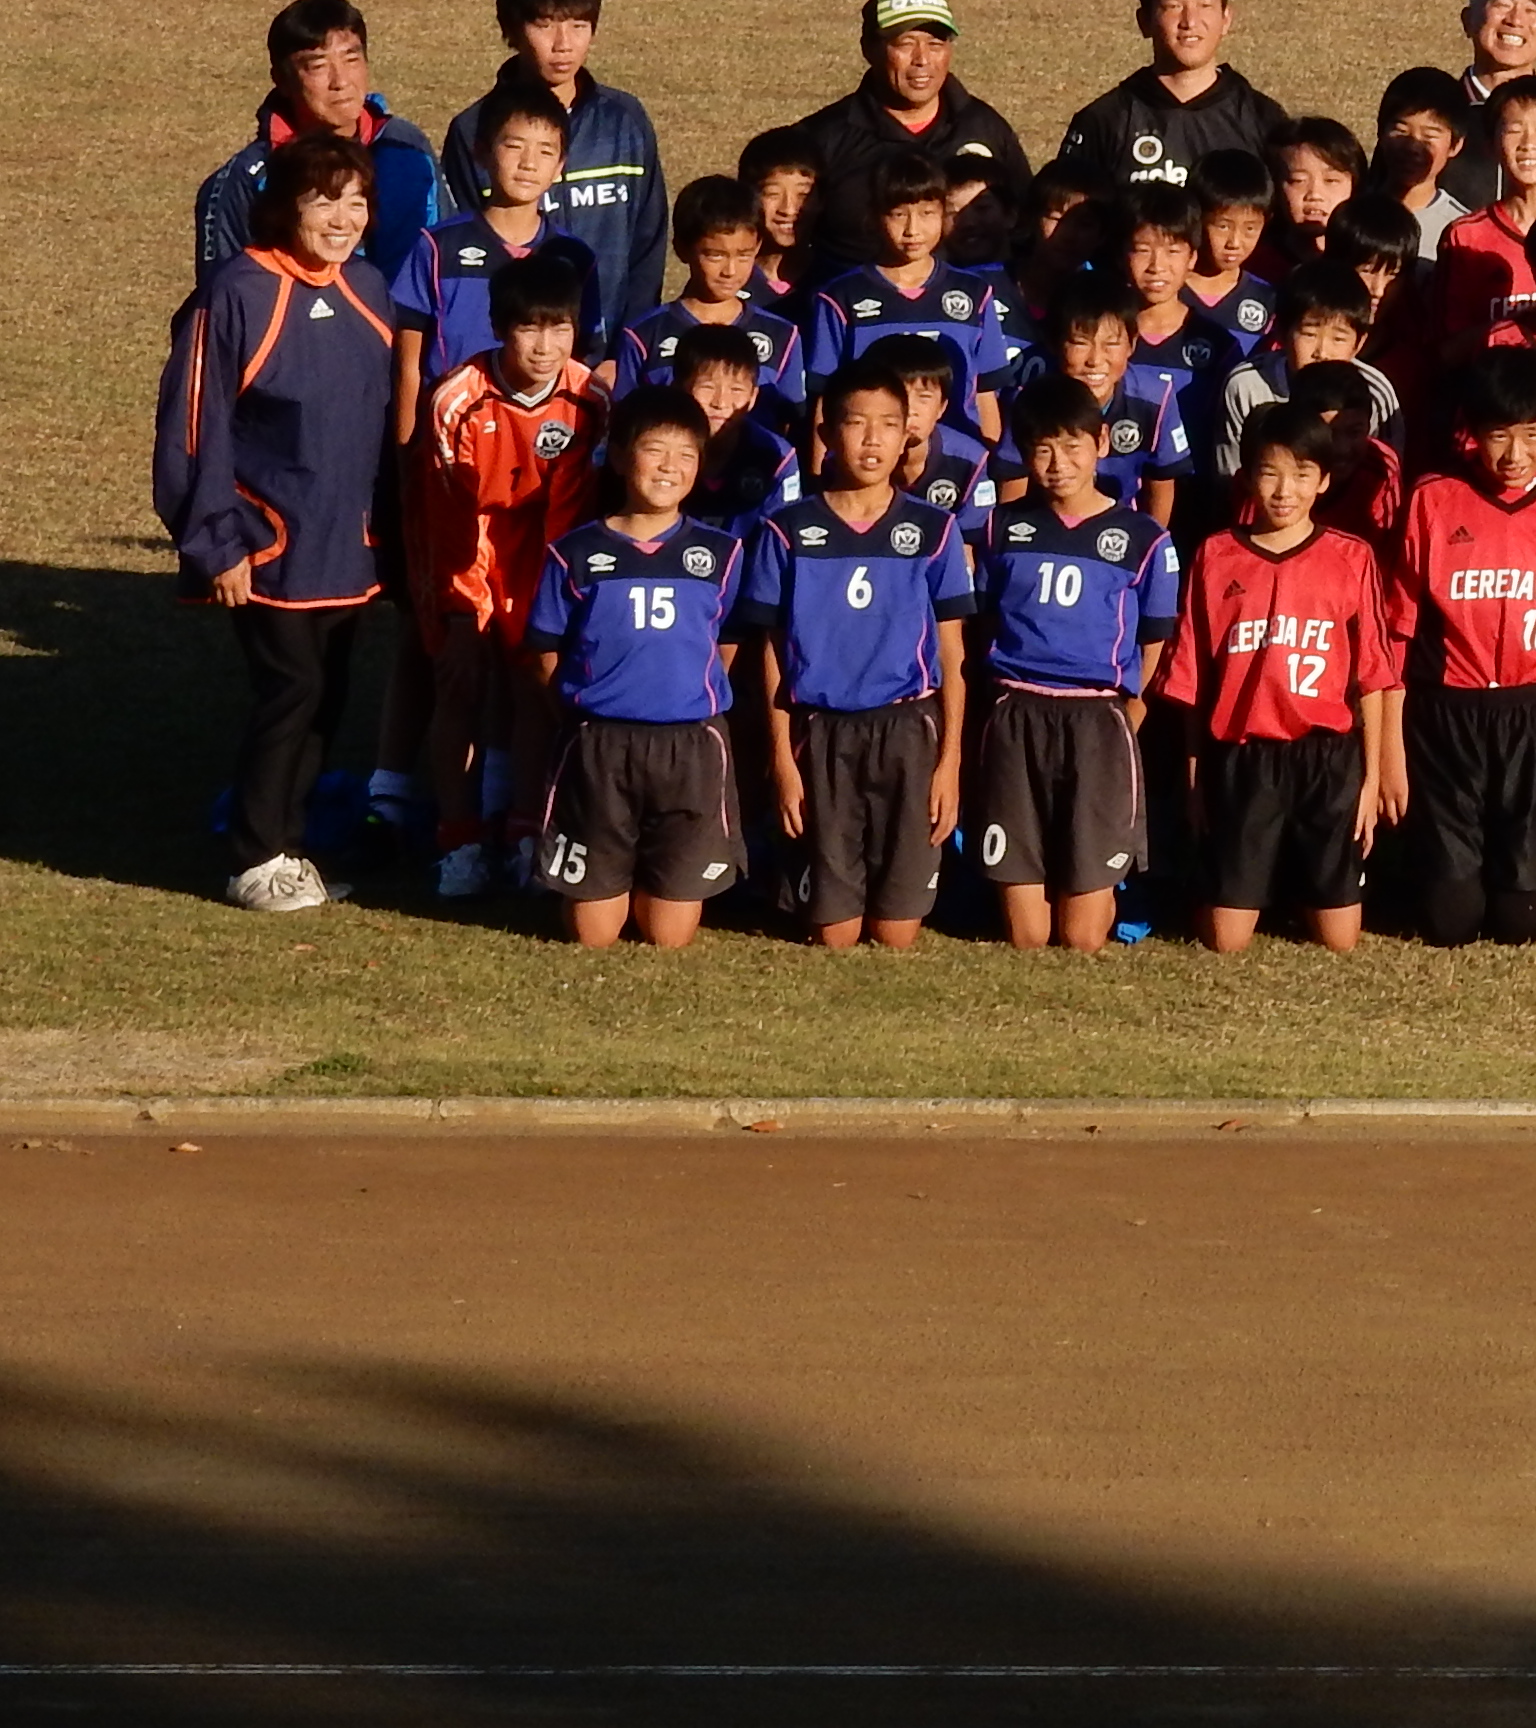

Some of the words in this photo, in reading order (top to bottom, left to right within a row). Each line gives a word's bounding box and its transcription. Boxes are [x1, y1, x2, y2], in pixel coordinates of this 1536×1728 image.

[847, 566, 873, 609] 6
[1038, 562, 1083, 607] 10
[628, 586, 676, 630] 15
[1301, 619, 1335, 652] FC
[1287, 653, 1327, 698] 12
[548, 832, 588, 885] 15
